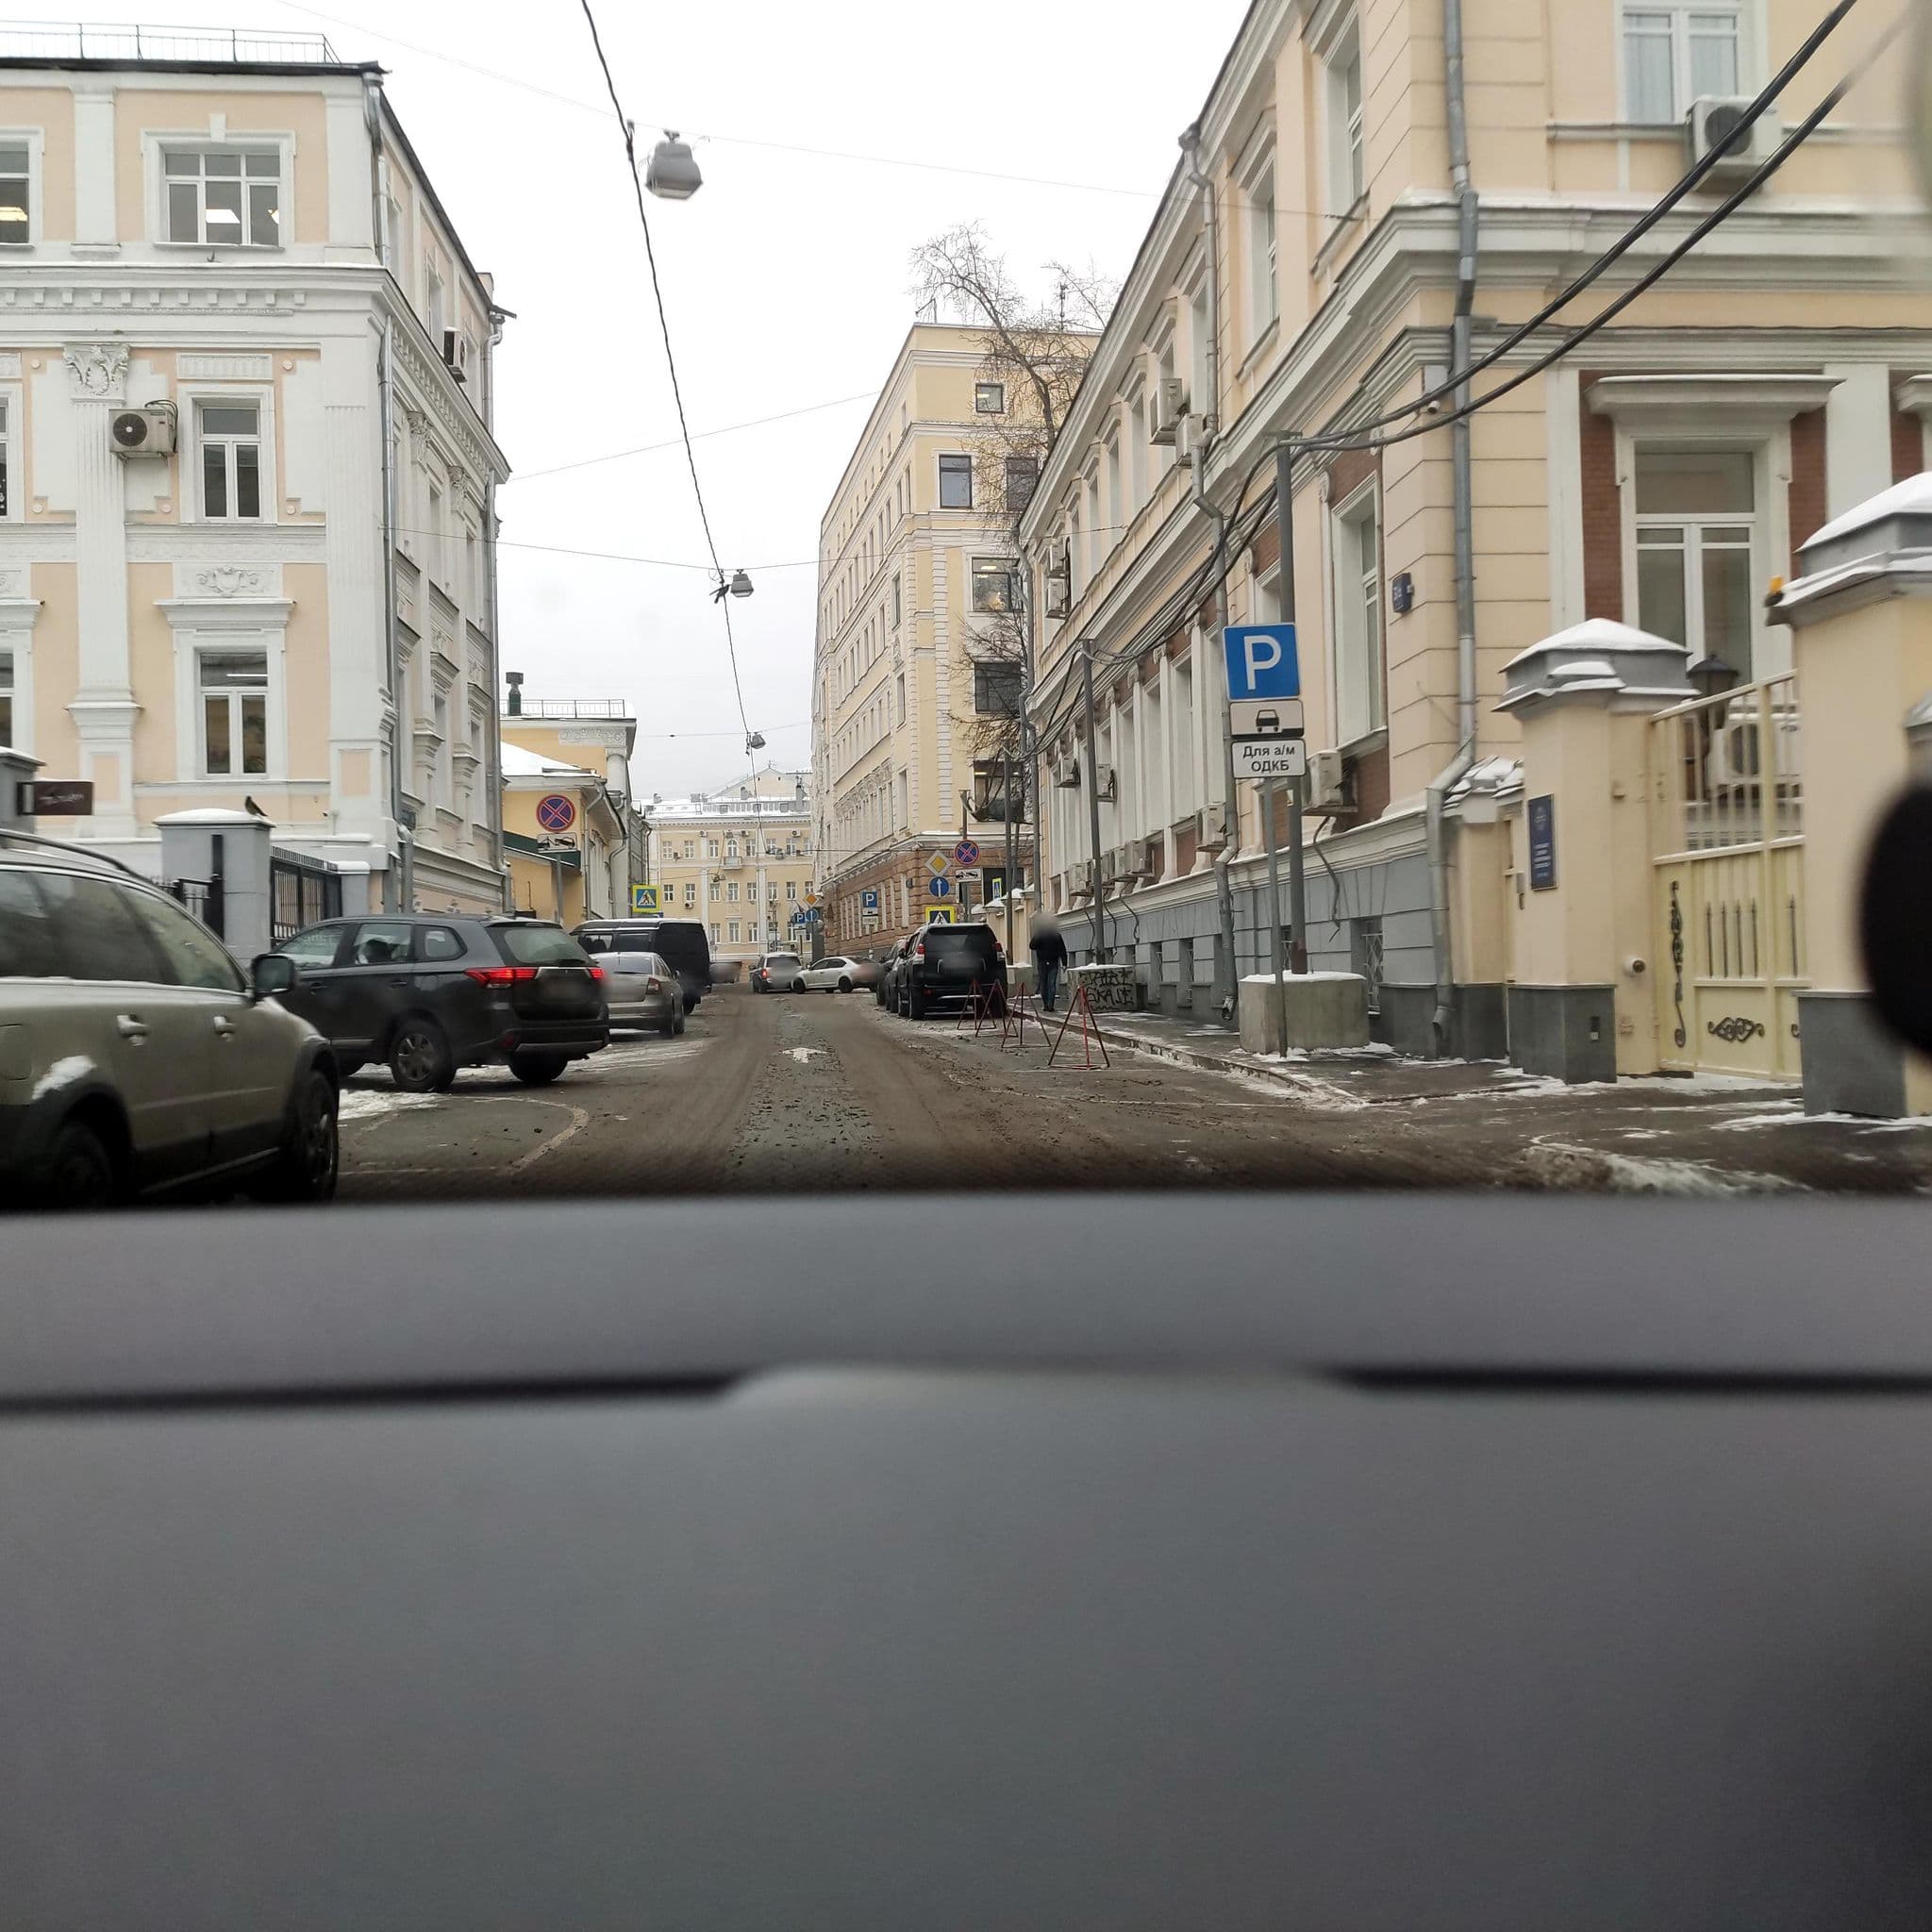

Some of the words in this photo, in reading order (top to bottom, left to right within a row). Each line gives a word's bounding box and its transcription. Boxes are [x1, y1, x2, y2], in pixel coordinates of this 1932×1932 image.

[1243, 635, 1282, 691] P
[1243, 745, 1270, 758] Для
[1274, 744, 1295, 756] а/м
[1251, 759, 1290, 774] ОДКБ
[865, 893, 874, 907] P
[796, 913, 804, 923] P
